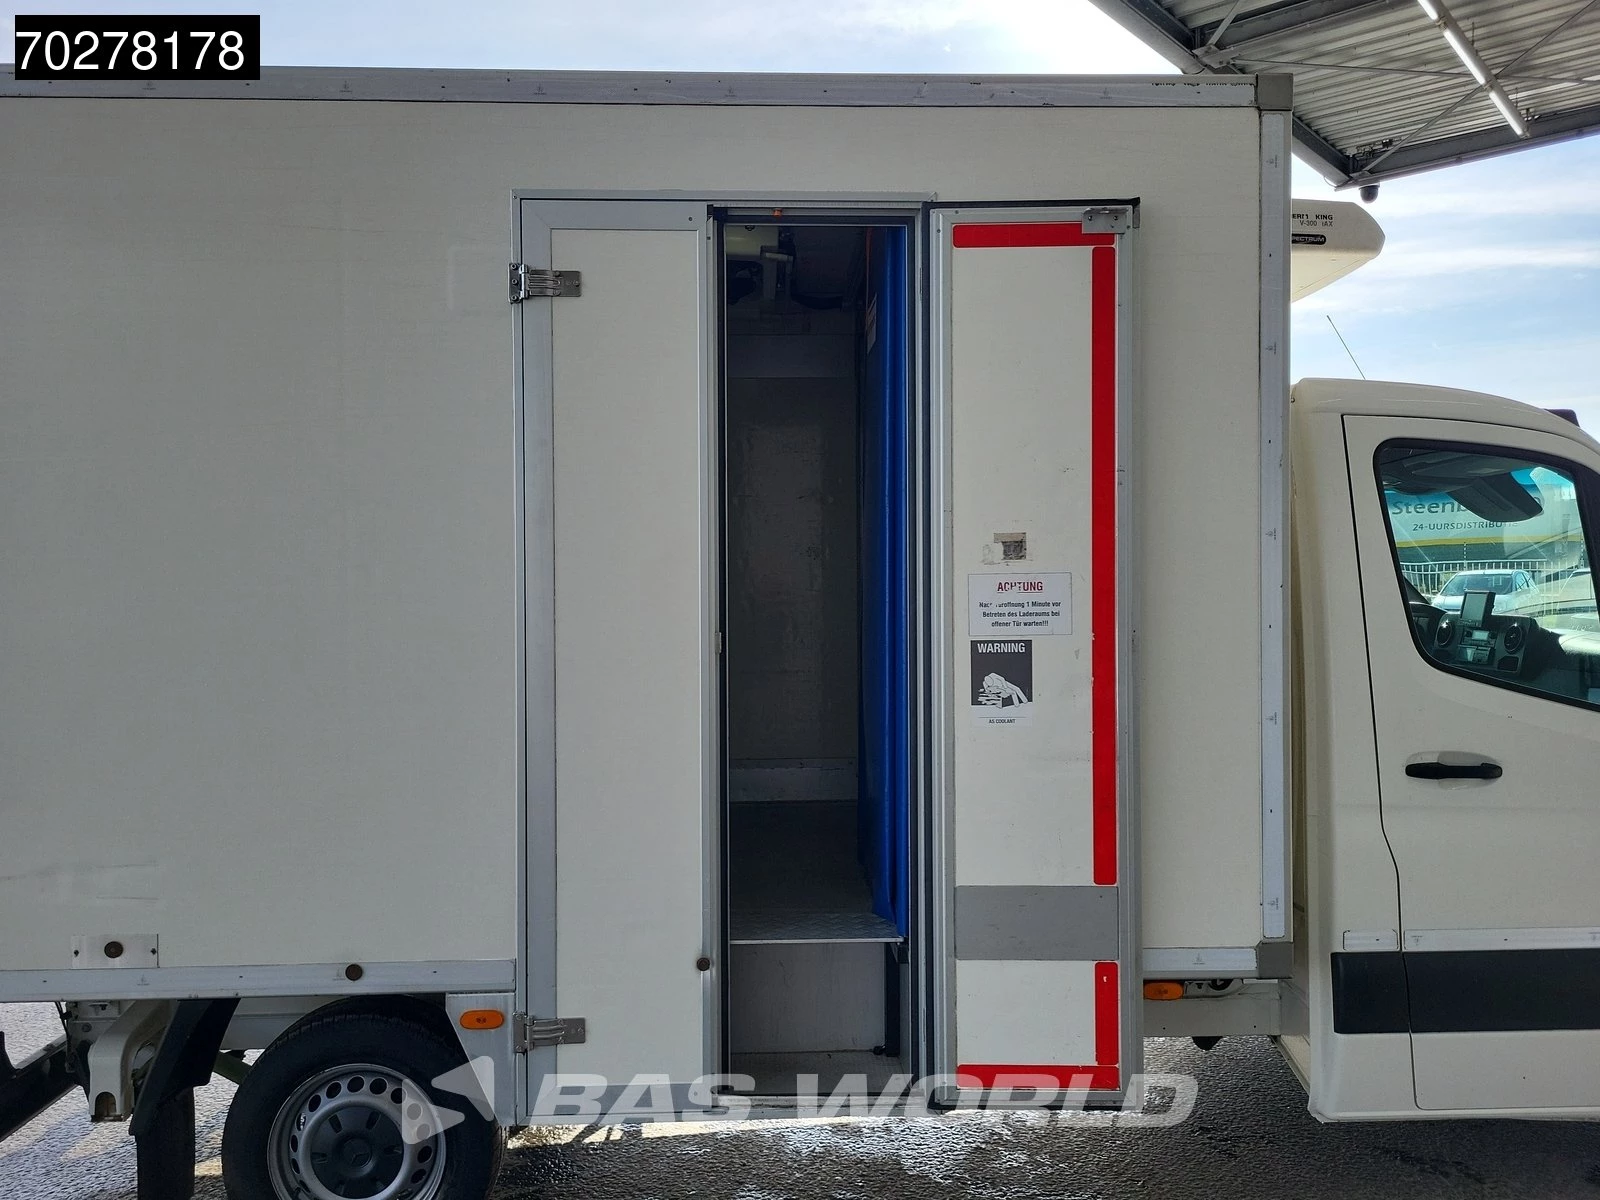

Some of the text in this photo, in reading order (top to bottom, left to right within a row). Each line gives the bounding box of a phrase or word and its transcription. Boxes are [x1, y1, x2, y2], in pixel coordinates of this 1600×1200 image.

[1391, 500, 1469, 515] Steenb
[997, 582, 1043, 592] ACHTUNG
[977, 643, 1025, 653] WARNING
